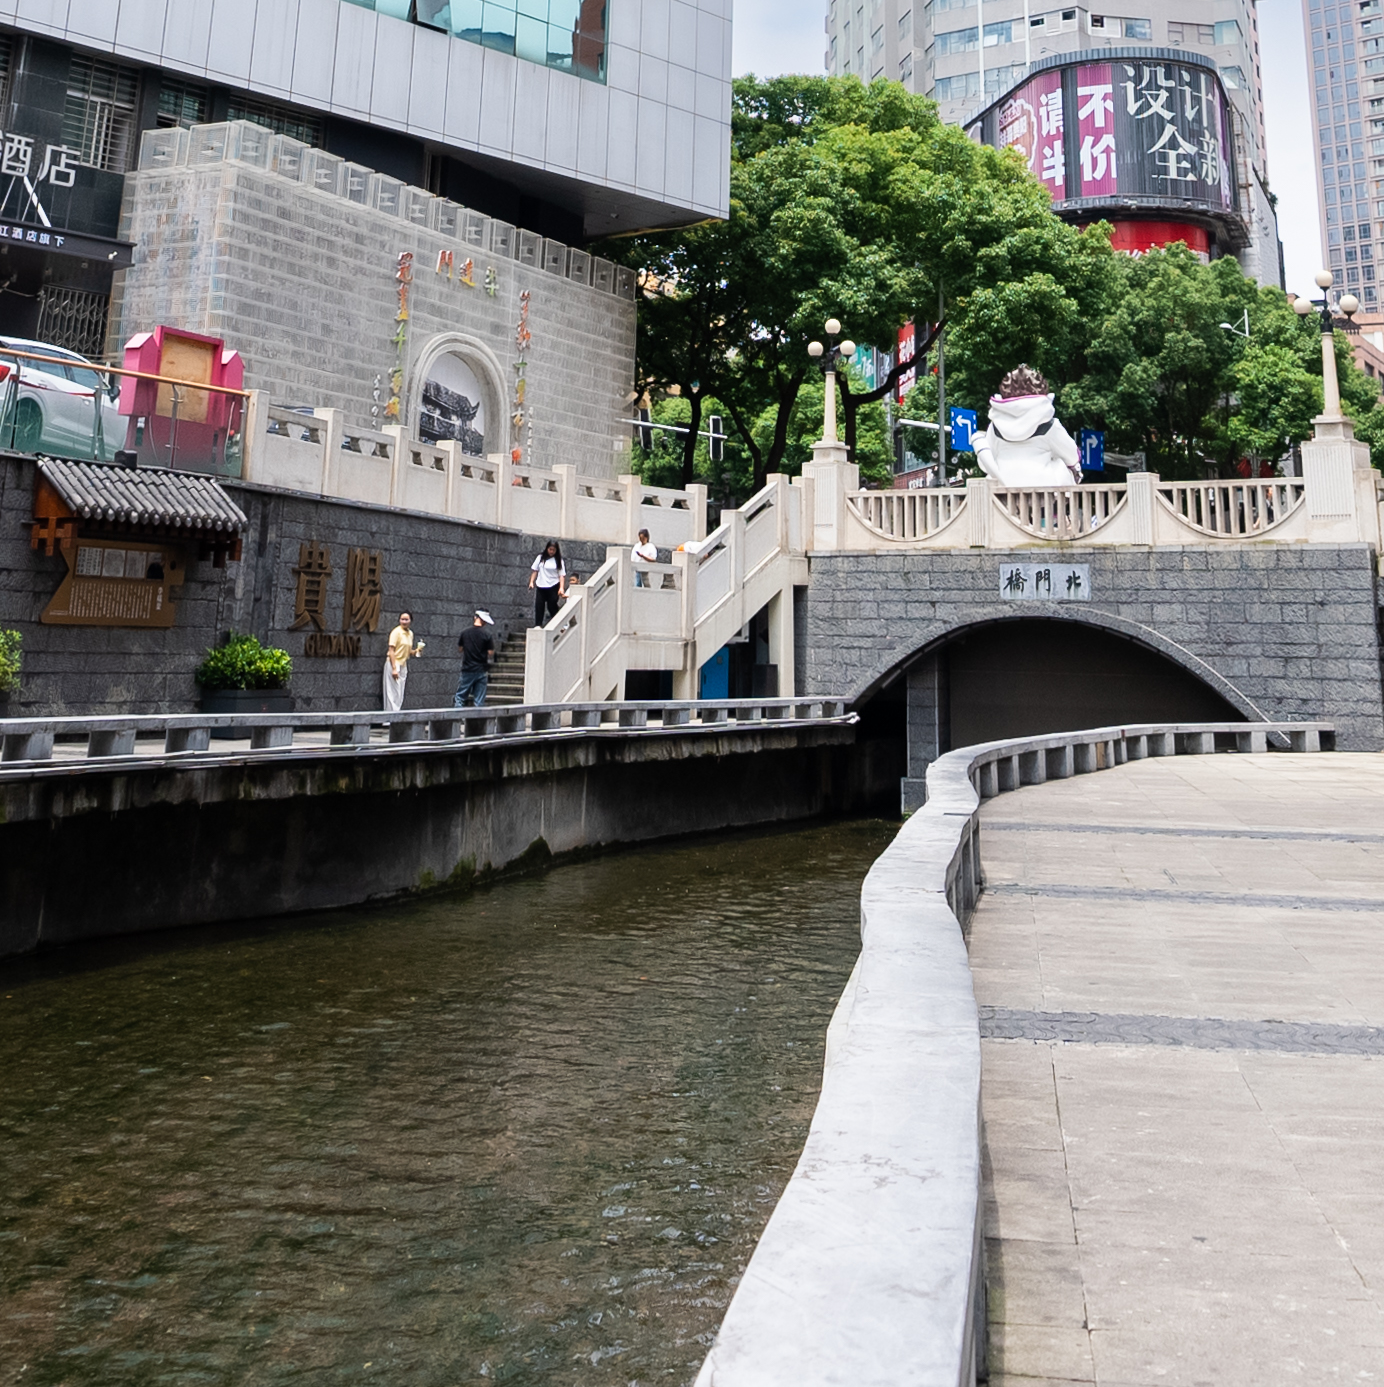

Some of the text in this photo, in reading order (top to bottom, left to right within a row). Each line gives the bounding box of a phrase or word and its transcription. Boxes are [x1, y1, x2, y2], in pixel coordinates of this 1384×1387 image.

[1120, 64, 1215, 127] 设计
[1148, 122, 1221, 186] 全新
[287, 539, 383, 632] 貴陽
[304, 634, 362, 658] GUIYANG
